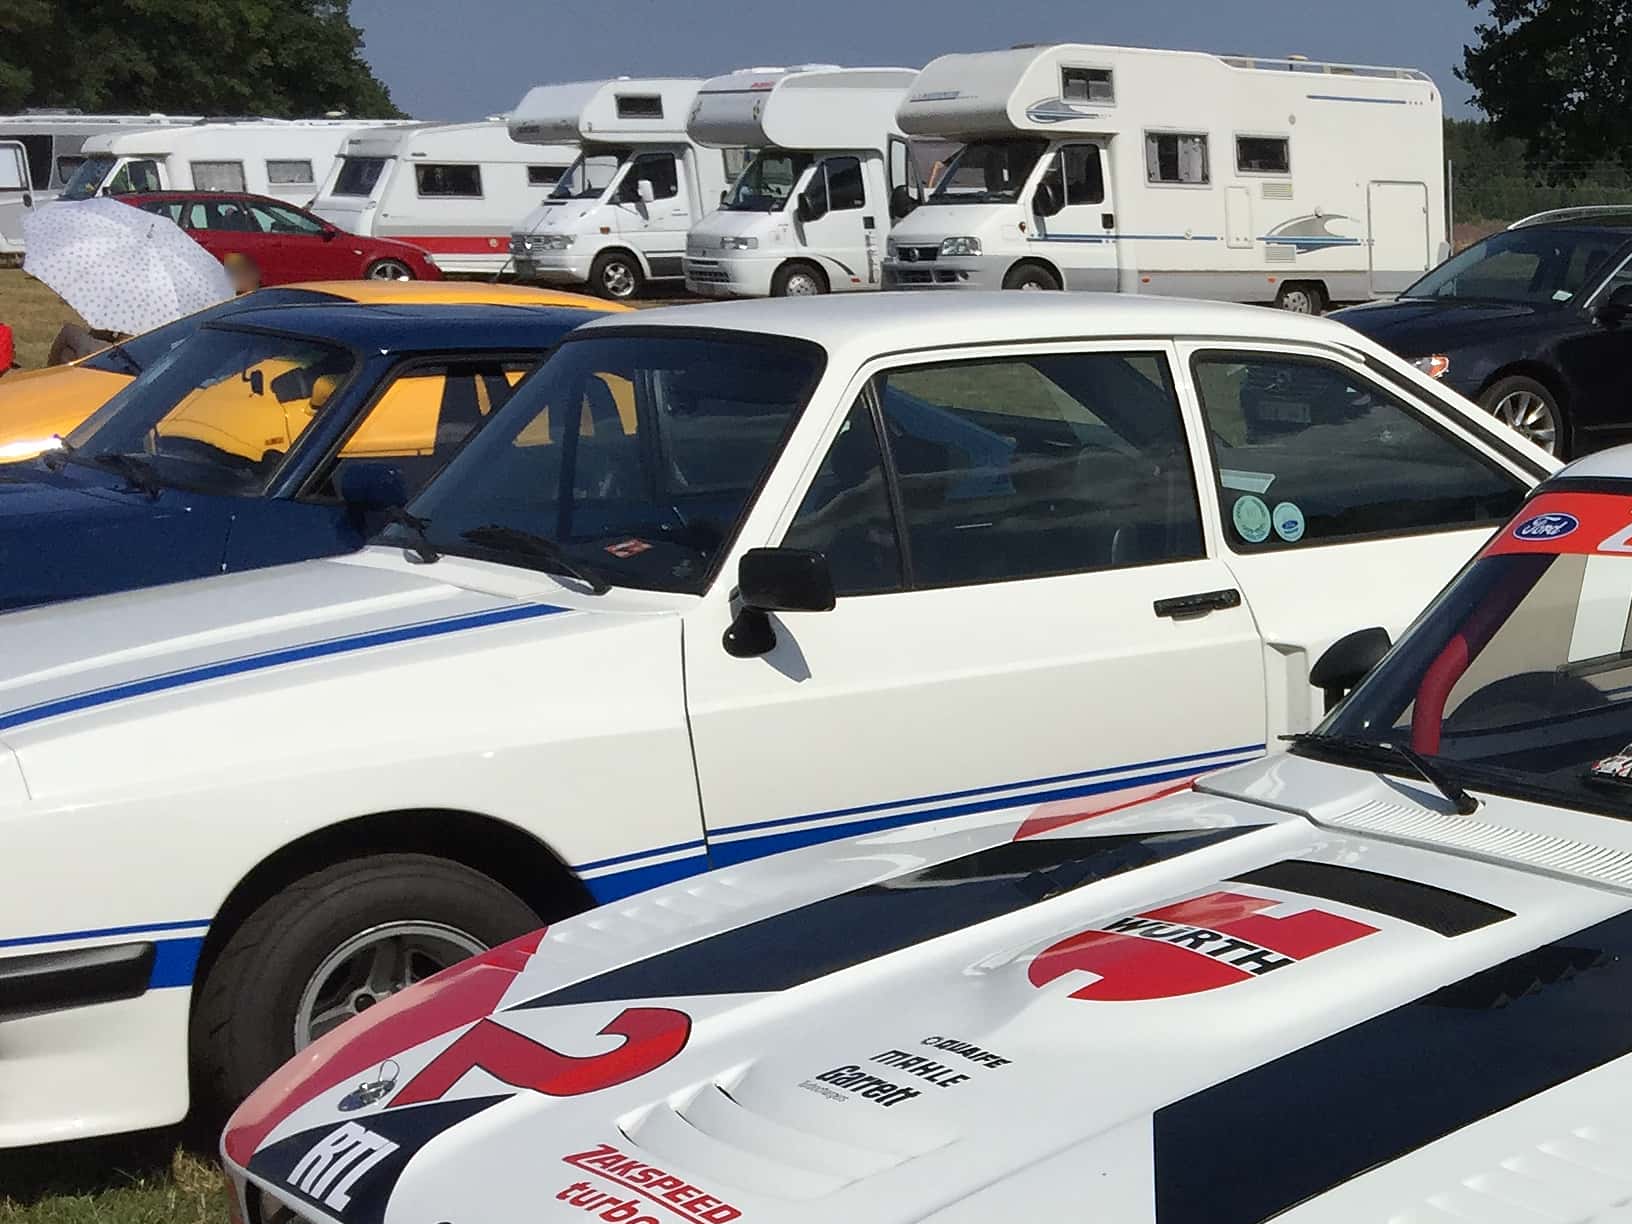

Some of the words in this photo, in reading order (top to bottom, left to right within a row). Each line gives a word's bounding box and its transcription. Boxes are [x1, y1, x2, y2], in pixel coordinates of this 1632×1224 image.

[1517, 514, 1573, 539] Ford
[383, 1006, 691, 1109] 2
[815, 1065, 922, 1107] Garrett
[287, 1119, 400, 1212] RTL
